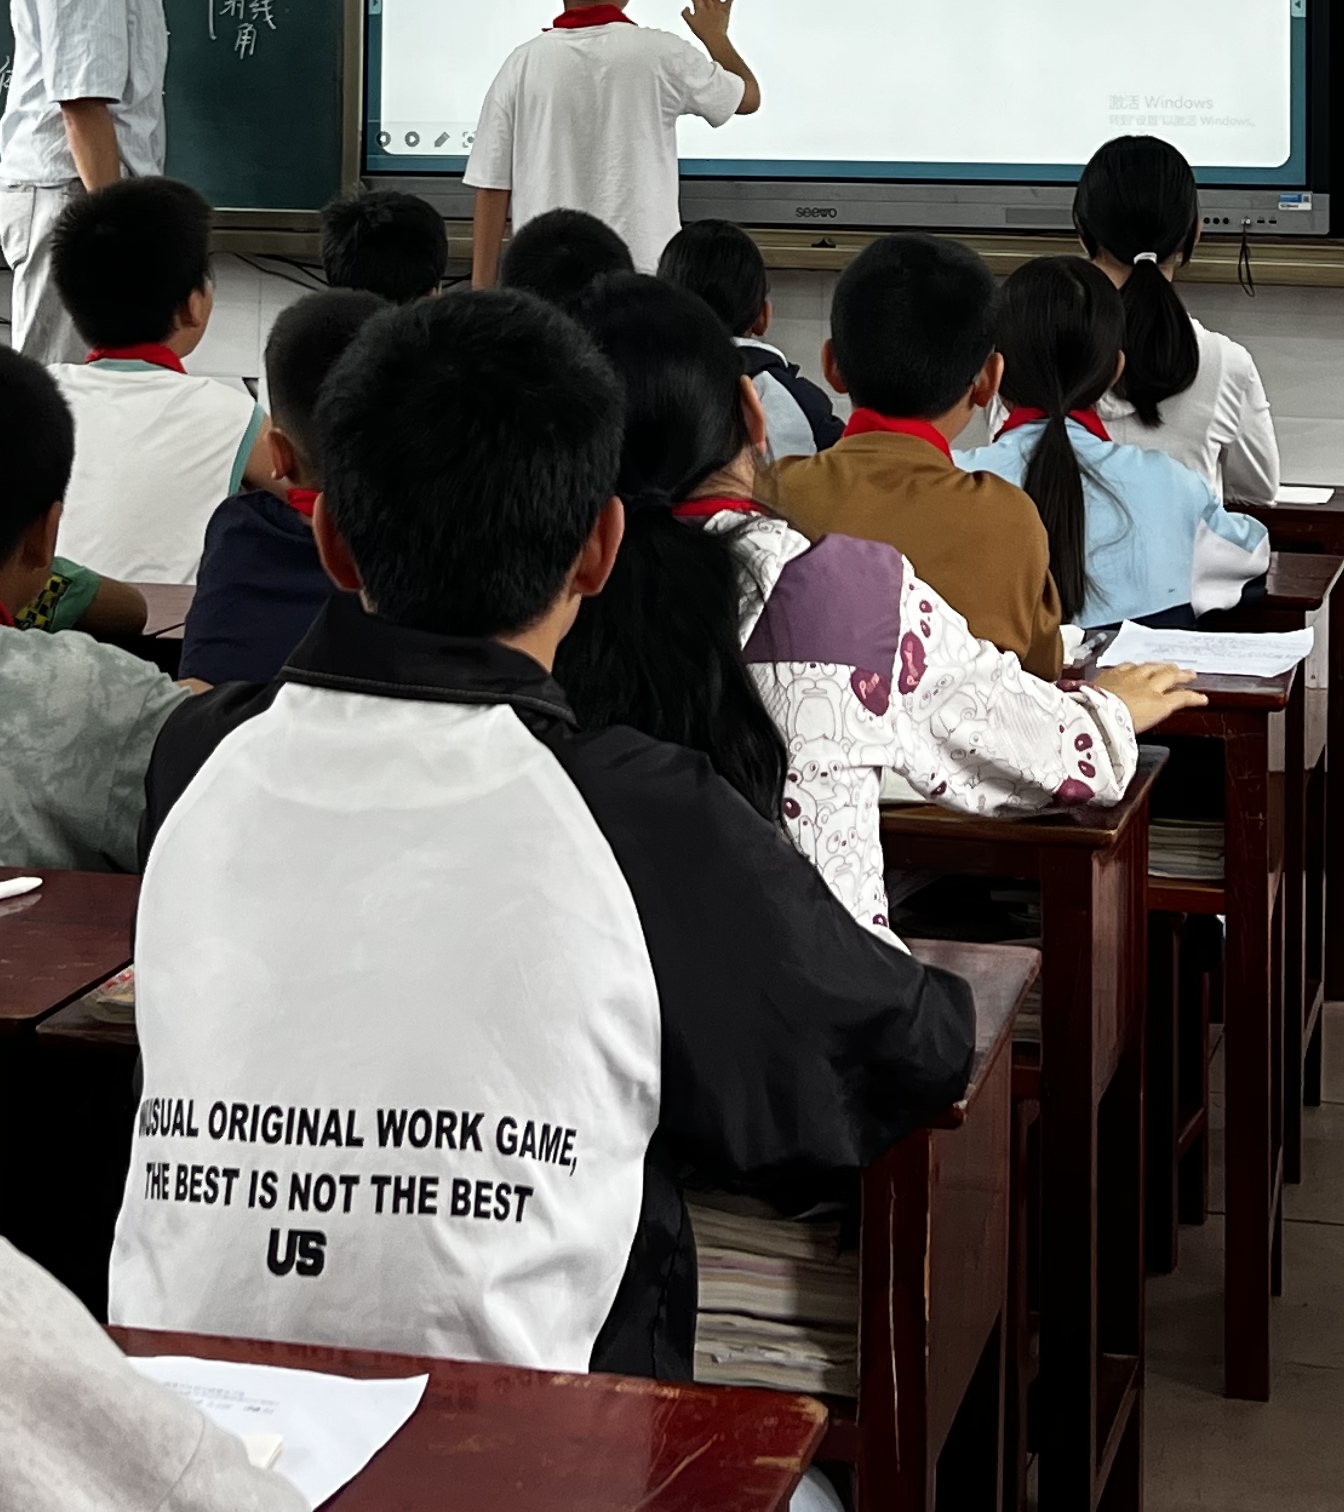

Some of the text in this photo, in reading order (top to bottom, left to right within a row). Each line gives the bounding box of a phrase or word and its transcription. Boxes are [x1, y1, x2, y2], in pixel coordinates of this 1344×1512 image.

[233, 22, 257, 60] 角
[1144, 94, 1214, 110] Windows
[795, 206, 838, 219] seewo
[208, 1100, 363, 1148] ORIGINAL
[376, 1108, 485, 1152] WORK
[495, 1115, 578, 1177] GAME,
[144, 1161, 534, 1223] THE BEST IS NOT THE BEST
[266, 1227, 327, 1278] US
